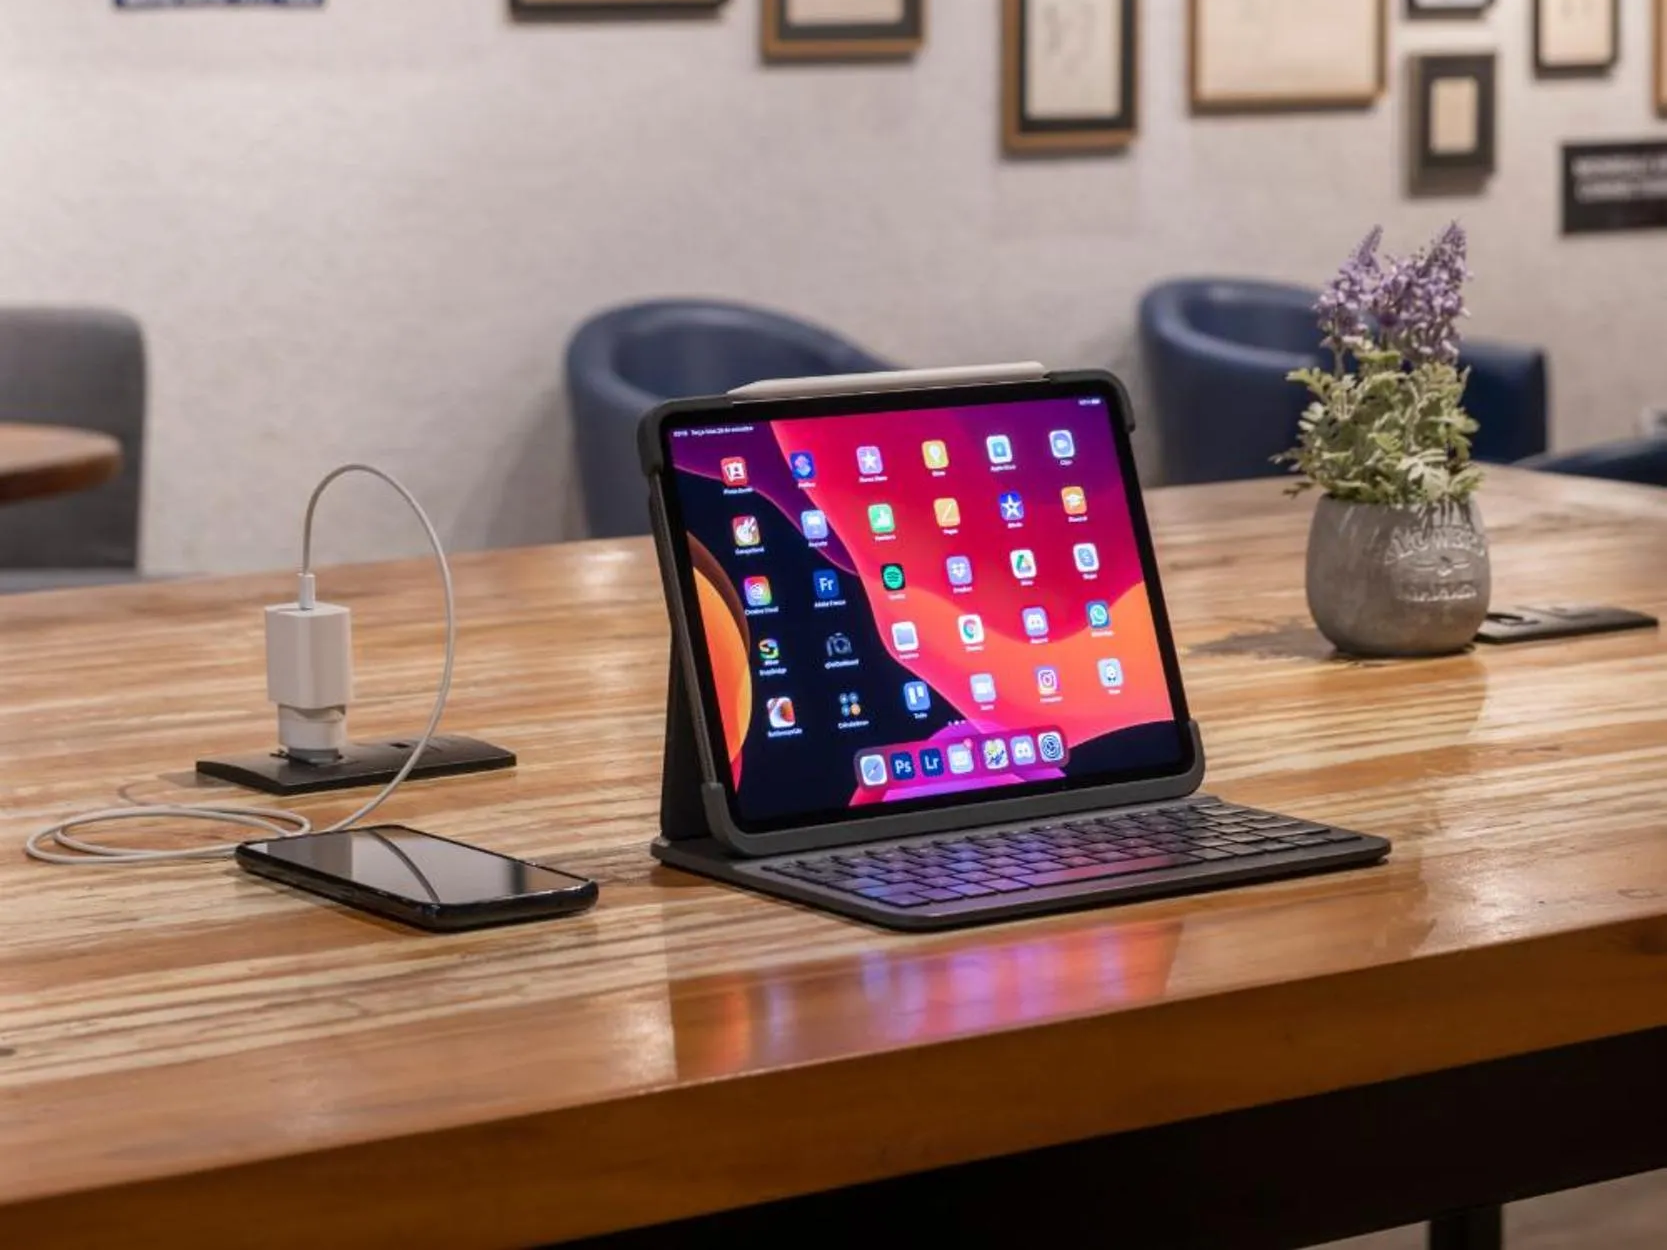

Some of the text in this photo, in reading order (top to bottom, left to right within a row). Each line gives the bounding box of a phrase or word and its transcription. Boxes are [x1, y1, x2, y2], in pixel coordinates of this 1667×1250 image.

[819, 577, 834, 592] Fr
[895, 759, 911, 775] Ps
[924, 754, 939, 769] Lr
